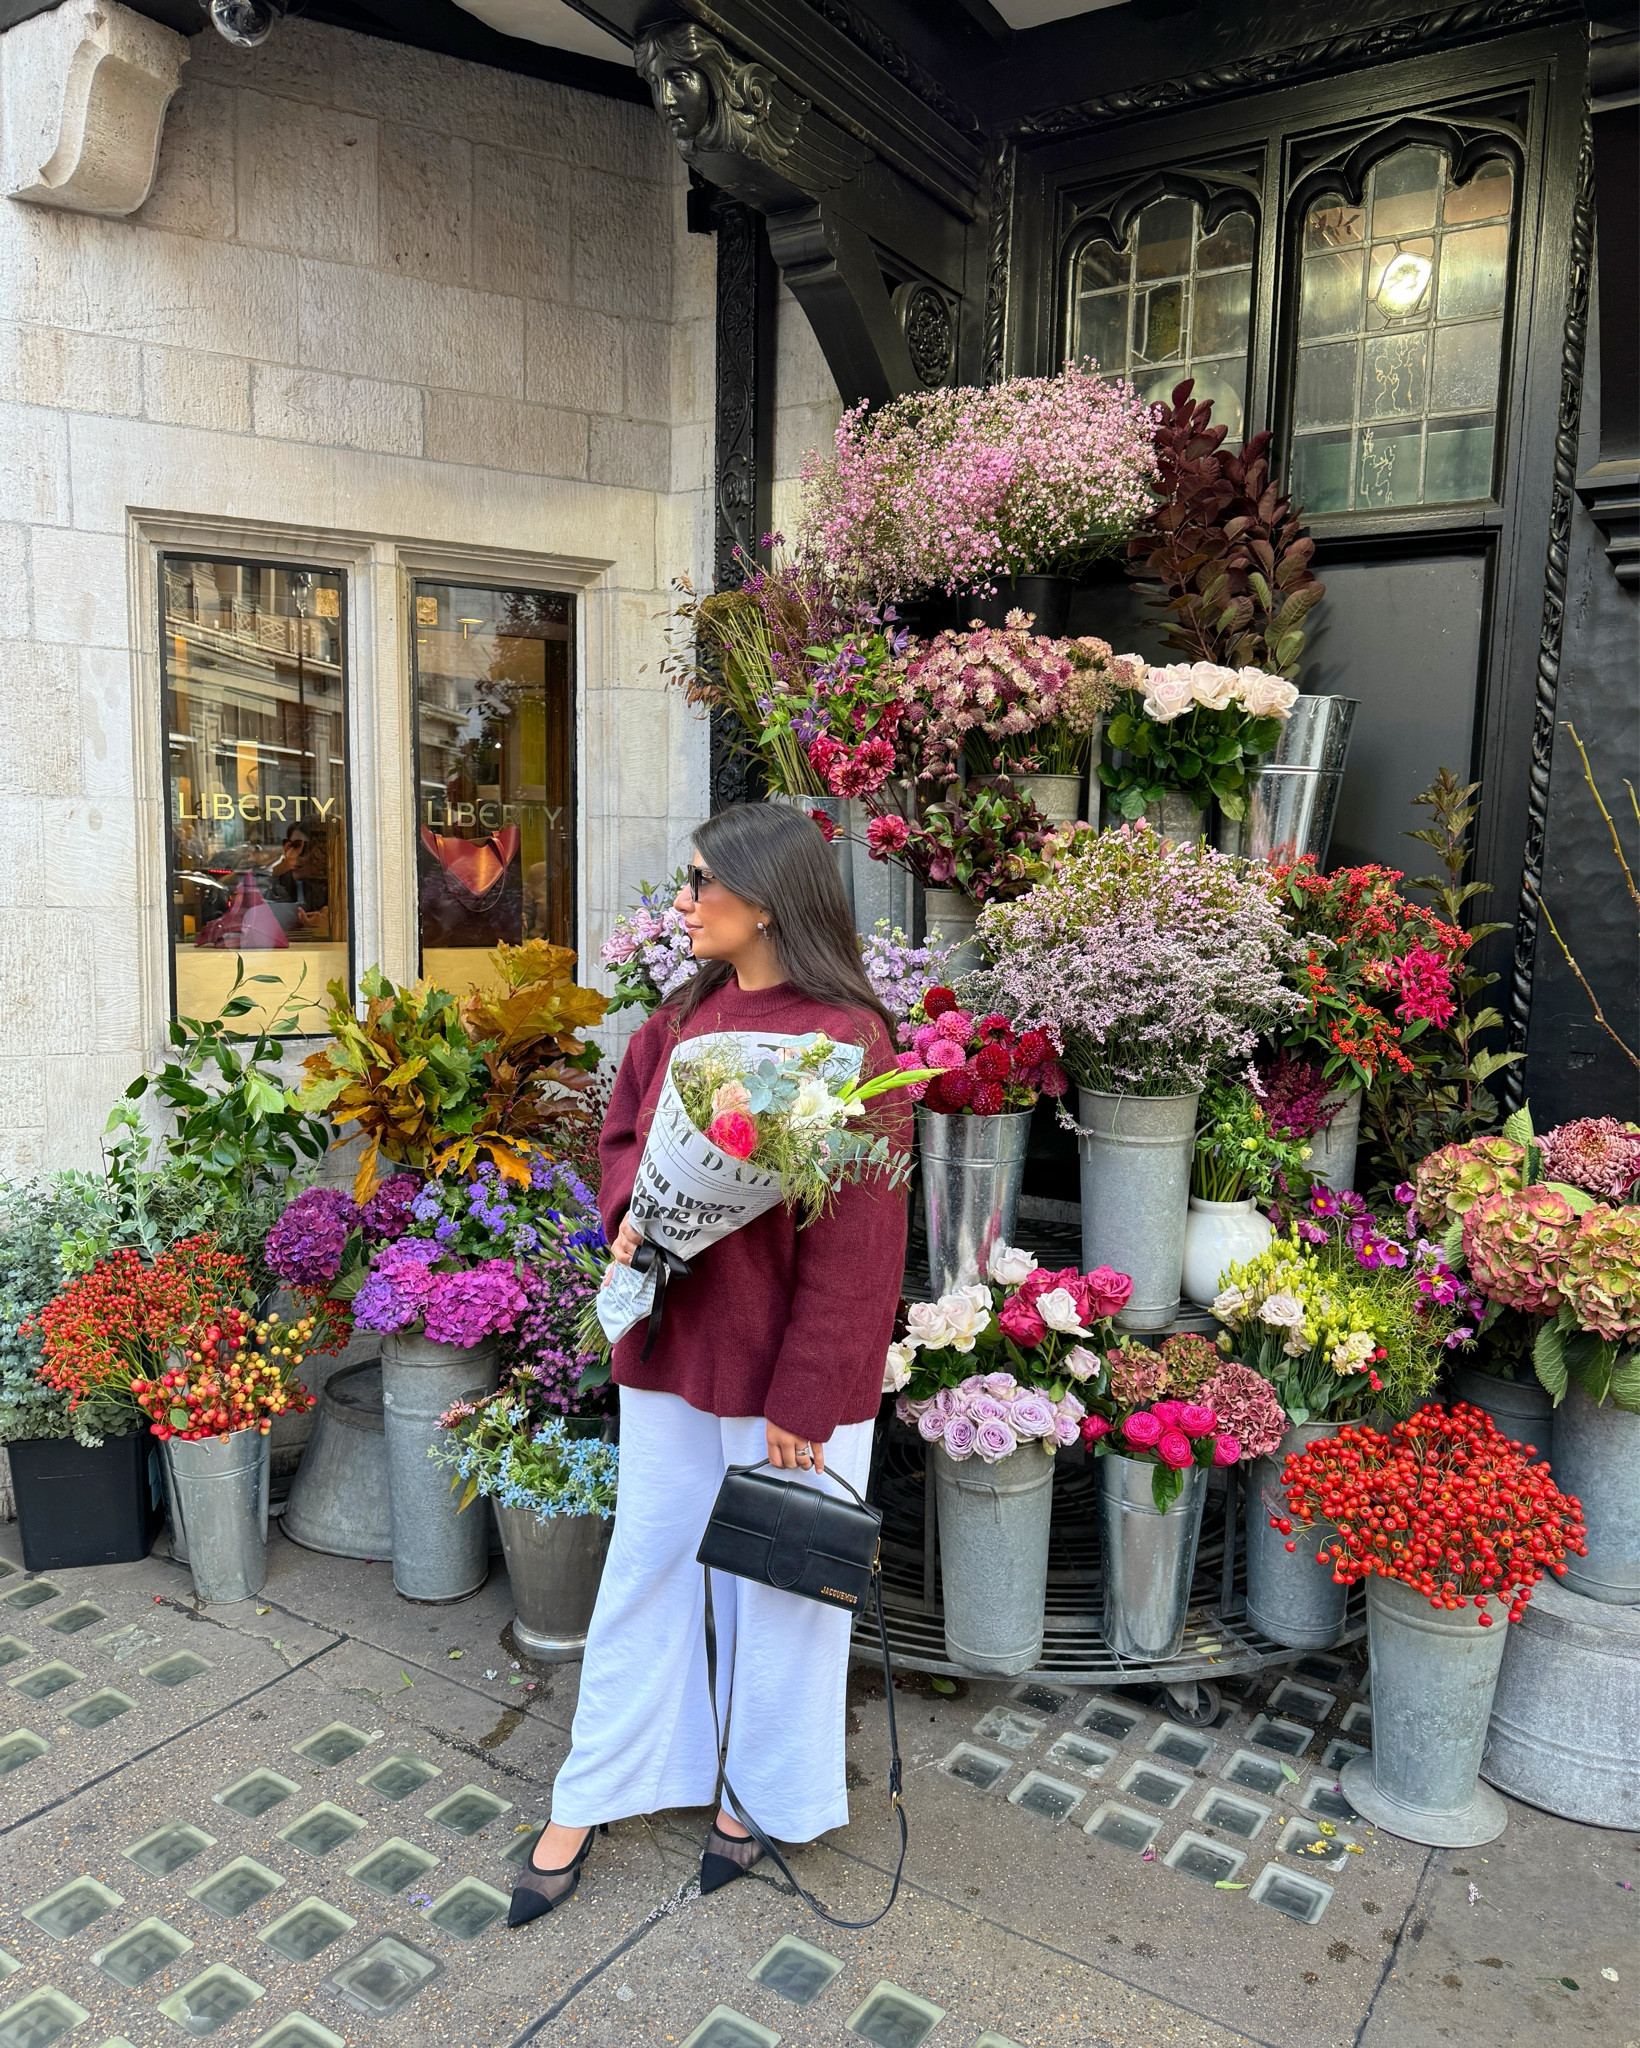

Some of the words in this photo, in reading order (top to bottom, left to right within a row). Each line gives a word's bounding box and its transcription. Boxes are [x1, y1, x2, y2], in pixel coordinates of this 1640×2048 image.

[676, 1191, 746, 1215] were
[697, 1210, 723, 1225] to
[820, 1585, 858, 1604] JACQUEMUS
